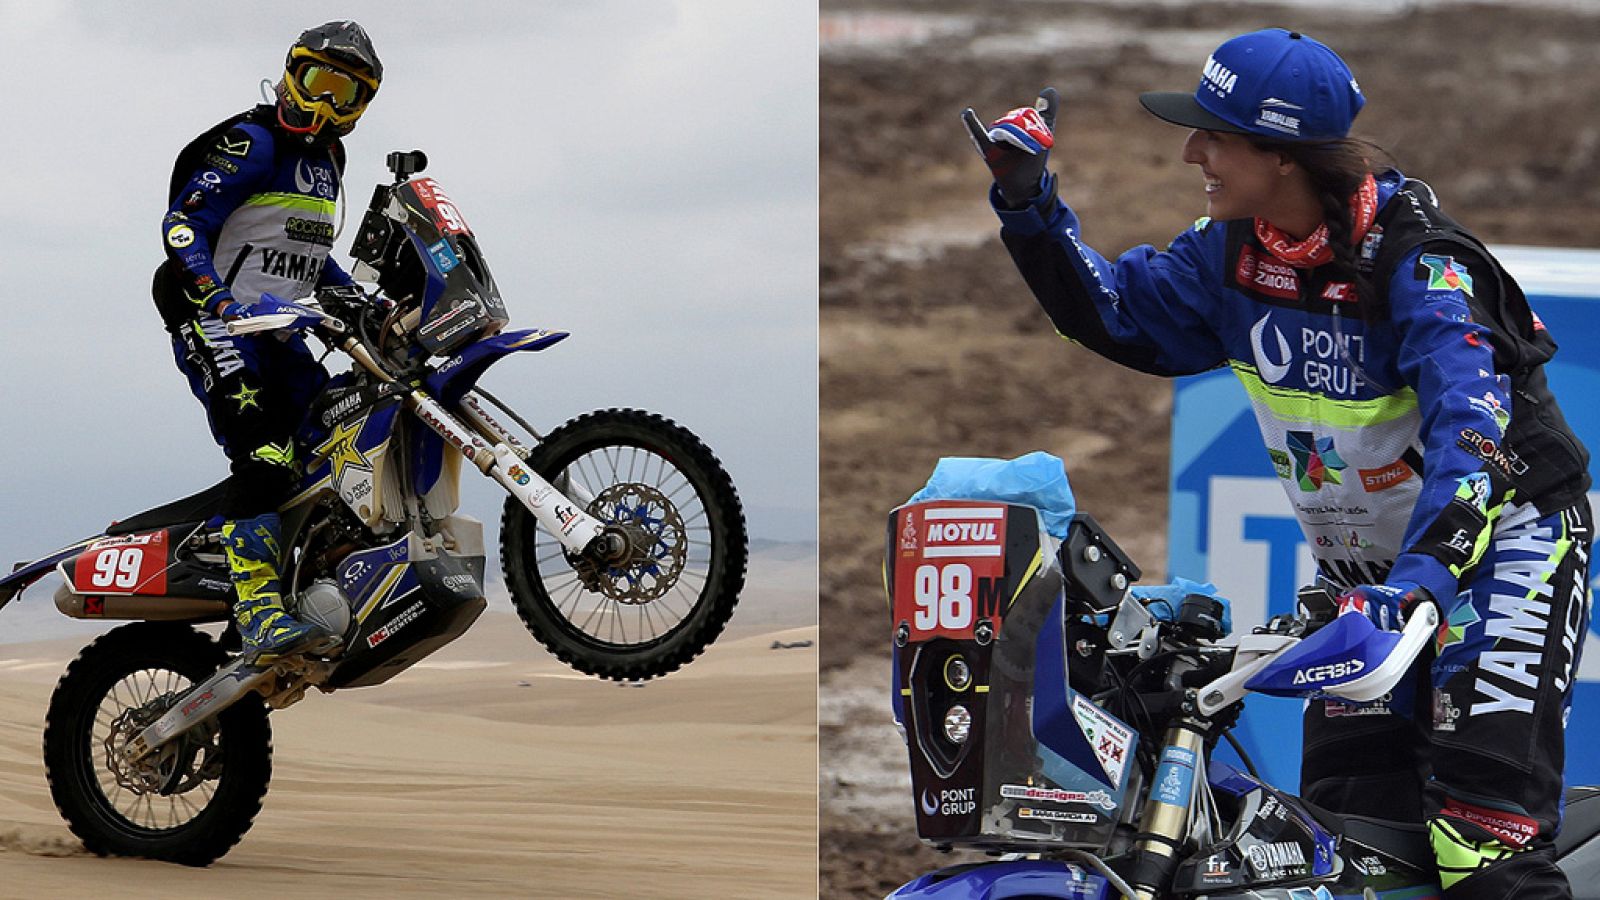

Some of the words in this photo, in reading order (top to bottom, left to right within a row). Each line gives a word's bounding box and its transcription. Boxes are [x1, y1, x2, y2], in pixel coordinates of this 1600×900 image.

[1302, 327, 1364, 362] PONT
[329, 391, 361, 418] YAMAHA
[1366, 468, 1405, 486] STIHL
[927, 523, 998, 541] MOTUL
[91, 547, 144, 588] 99
[914, 563, 973, 631] 98
[1470, 502, 1555, 716] YAMAHA
[1293, 658, 1365, 685] ACERBIS
[941, 788, 975, 801] PONT
[941, 803, 976, 816] GRUP
[1465, 811, 1520, 830] DIPUTACIÓN
[1521, 825, 1535, 834] DE
[1264, 842, 1306, 869] YAMAHA
[1261, 868, 1307, 879] RACING
